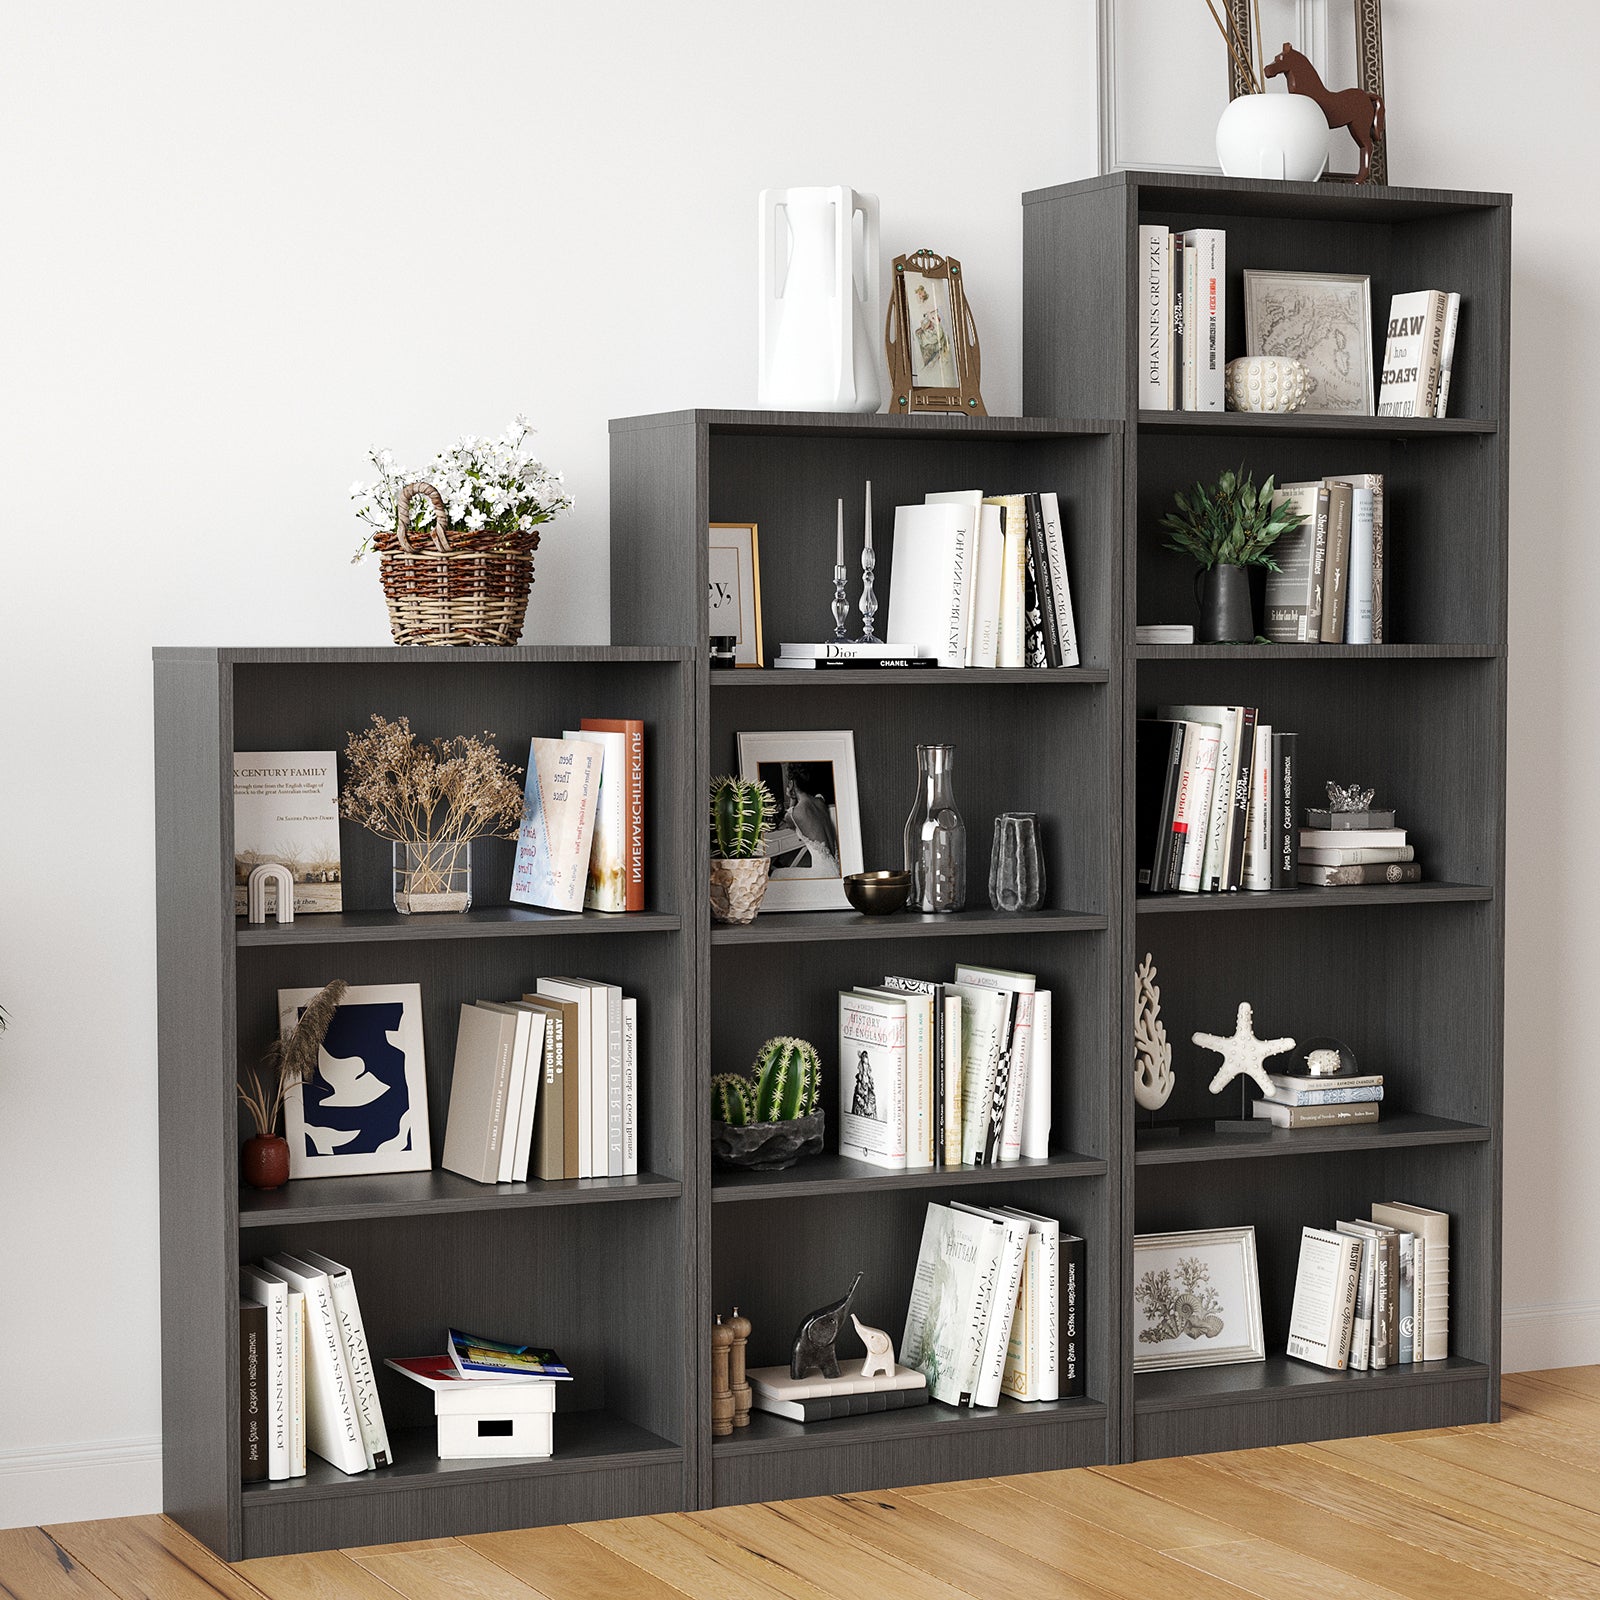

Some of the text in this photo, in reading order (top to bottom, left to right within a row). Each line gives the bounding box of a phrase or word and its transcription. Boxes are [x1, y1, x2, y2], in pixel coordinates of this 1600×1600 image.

[1149, 237, 1160, 386] JOHANNES GRÜTZKE
[1314, 513, 1327, 575] Sherlock Holmes
[826, 644, 857, 657] Dior
[241, 768, 288, 778] CENTURY
[290, 768, 327, 777] FAMILY
[1177, 771, 1190, 818] ПОСОБИЕ
[843, 1025, 854, 1036] OF
[855, 1027, 888, 1043] ENGLAND
[850, 1013, 880, 1028] HISTORY
[1349, 1243, 1360, 1271] TOLSTOY
[1346, 1274, 1355, 1304] Anna
[1380, 1260, 1388, 1312] Sherlock Holmes
[1340, 1306, 1351, 1355] Karenina
[276, 1368, 284, 1450] JOHANNES
[334, 1363, 357, 1443] JOHANNES
